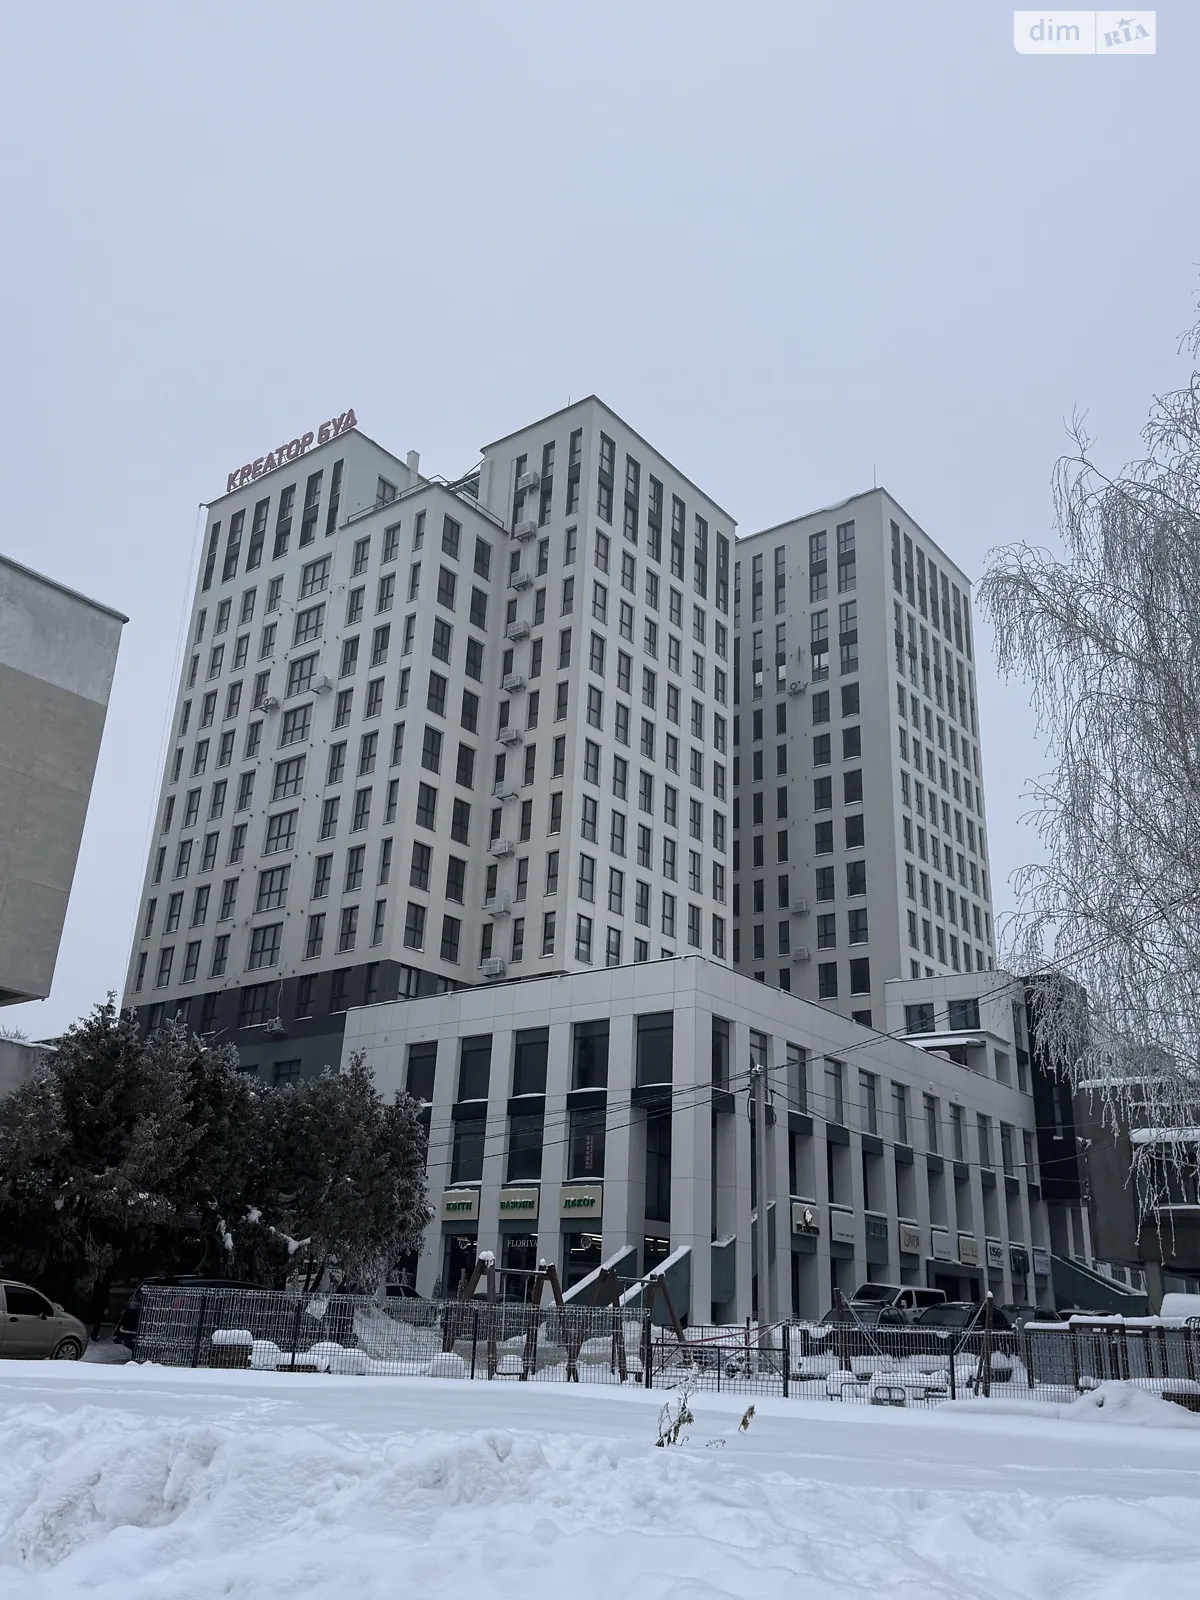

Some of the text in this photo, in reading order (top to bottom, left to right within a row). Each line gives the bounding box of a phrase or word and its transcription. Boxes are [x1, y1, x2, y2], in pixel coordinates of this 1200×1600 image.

[226, 408, 358, 493] КРЕАТОР БУД
[563, 1197, 596, 1209] ДЕКОР
